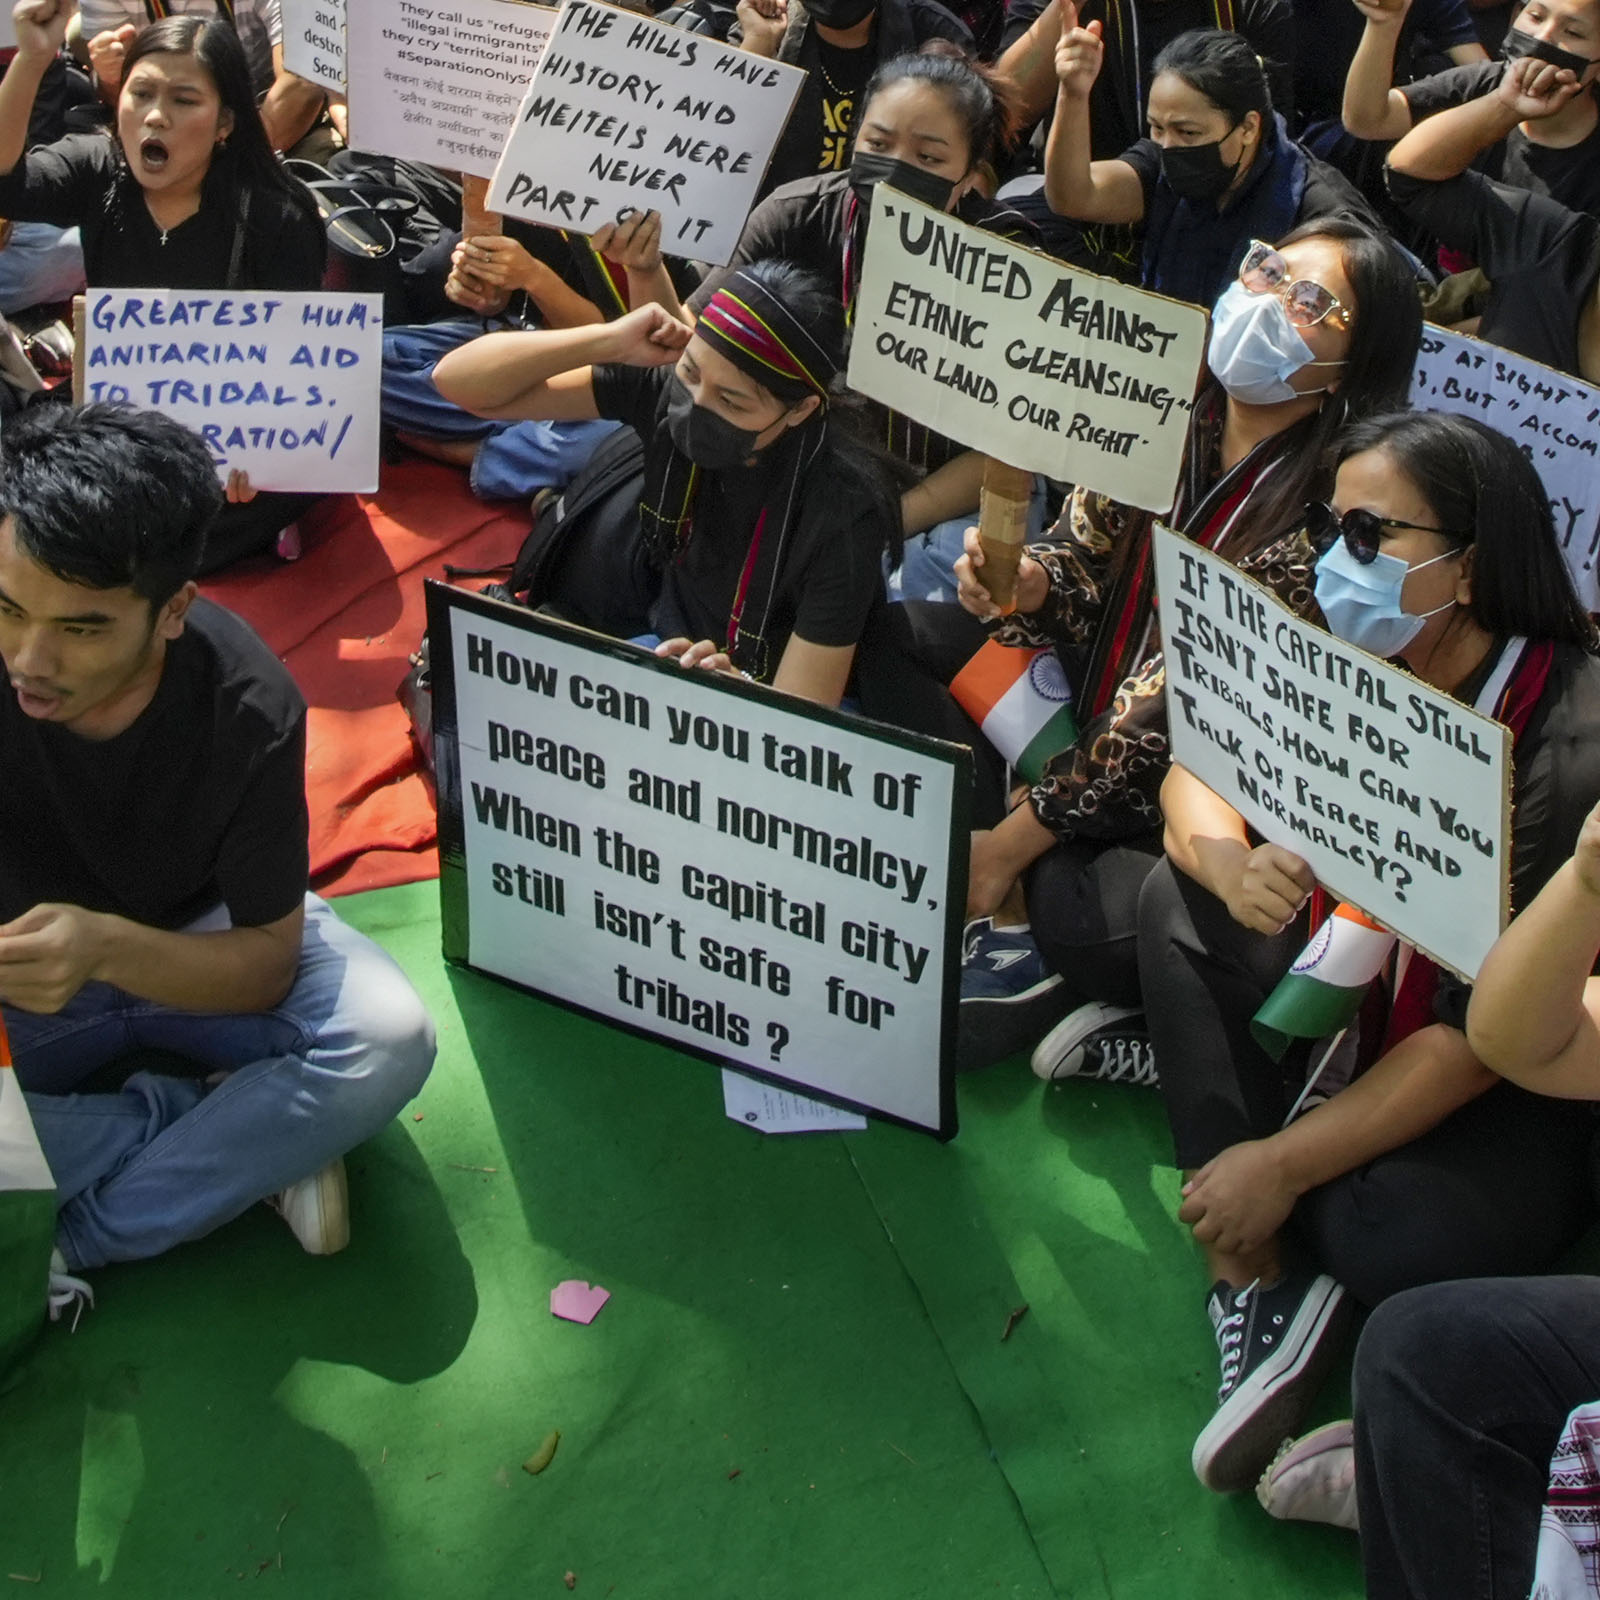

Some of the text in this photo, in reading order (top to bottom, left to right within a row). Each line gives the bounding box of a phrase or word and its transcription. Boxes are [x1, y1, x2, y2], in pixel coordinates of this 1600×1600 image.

[885, 281, 988, 349] ETHNIC
[1038, 278, 1178, 358] AGAINST
[933, 357, 999, 409] LAND,
[1008, 395, 1060, 432] OUR
[467, 633, 921, 817] How can you talk of
[489, 721, 938, 911] peace and normalcy,
[471, 781, 928, 984] When the capital city
[492, 862, 895, 1030] still isn't safe for
[615, 965, 749, 1047] tribals
